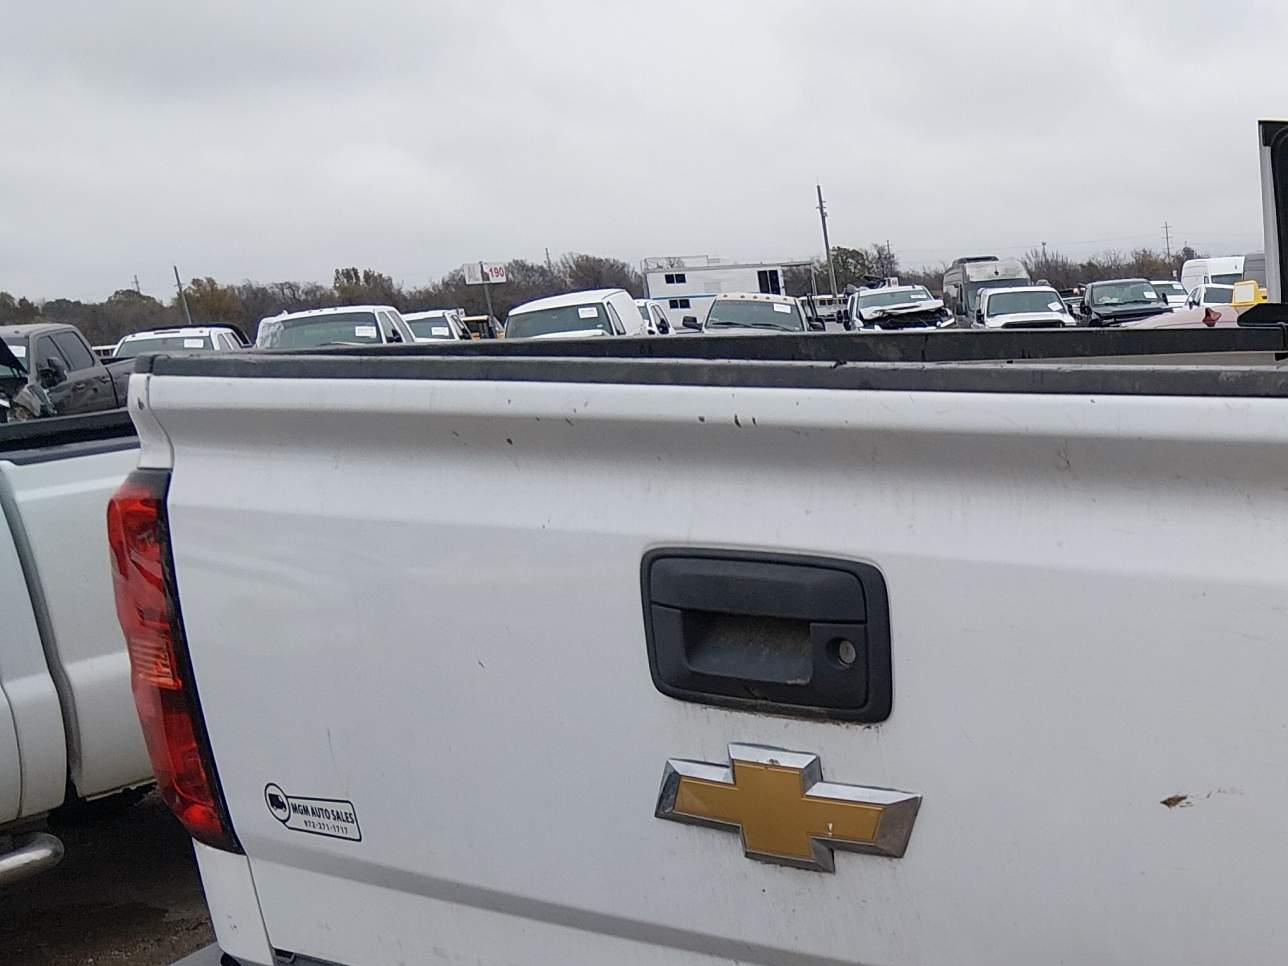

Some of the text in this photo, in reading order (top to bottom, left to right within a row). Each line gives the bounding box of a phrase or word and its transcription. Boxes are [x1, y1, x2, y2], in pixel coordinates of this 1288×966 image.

[489, 266, 505, 278] 190
[291, 803, 355, 825] MGM AUTO SALES
